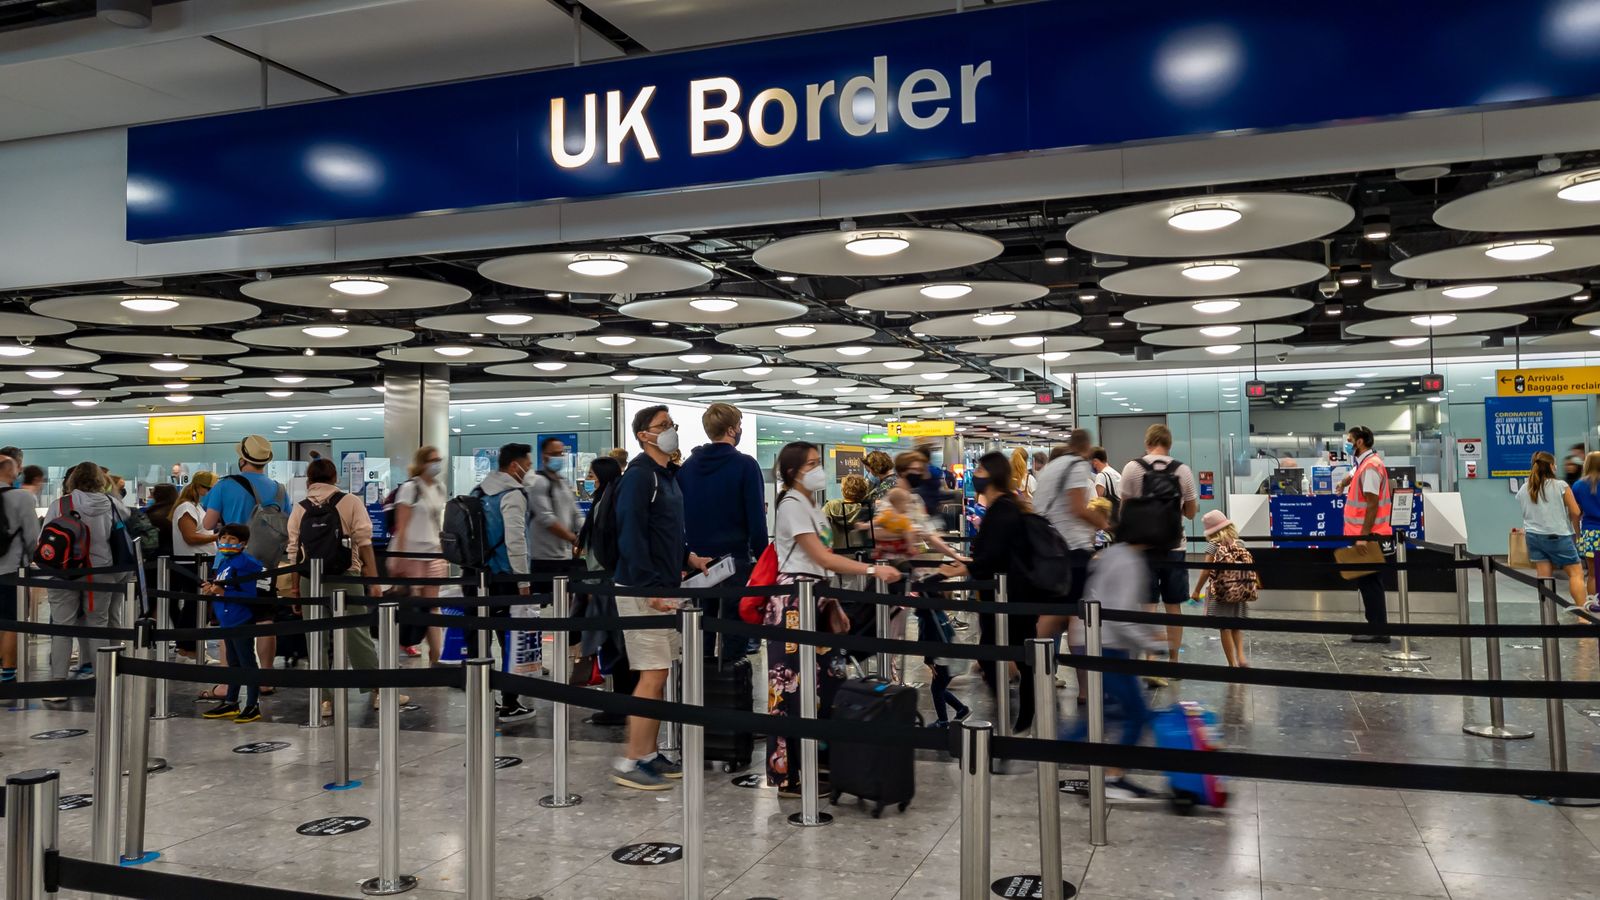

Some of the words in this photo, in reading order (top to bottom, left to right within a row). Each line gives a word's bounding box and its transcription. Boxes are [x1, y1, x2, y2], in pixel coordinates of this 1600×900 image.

[550, 85, 660, 168] UK
[690, 55, 992, 155] Border
[1527, 374, 1564, 382] Arrivals
[1527, 383, 1568, 392] Baggage
[1495, 423, 1515, 435] STAY
[1518, 422, 1543, 434] ALERT
[1496, 435, 1505, 445] TO
[1507, 435, 1525, 445] STAY
[1526, 434, 1544, 445] SAFE
[1330, 499, 1344, 509] 15
[1004, 887, 1016, 897] KEEP
[1010, 876, 1023, 888] YOUR
[1017, 879, 1034, 897] DISTANCE
